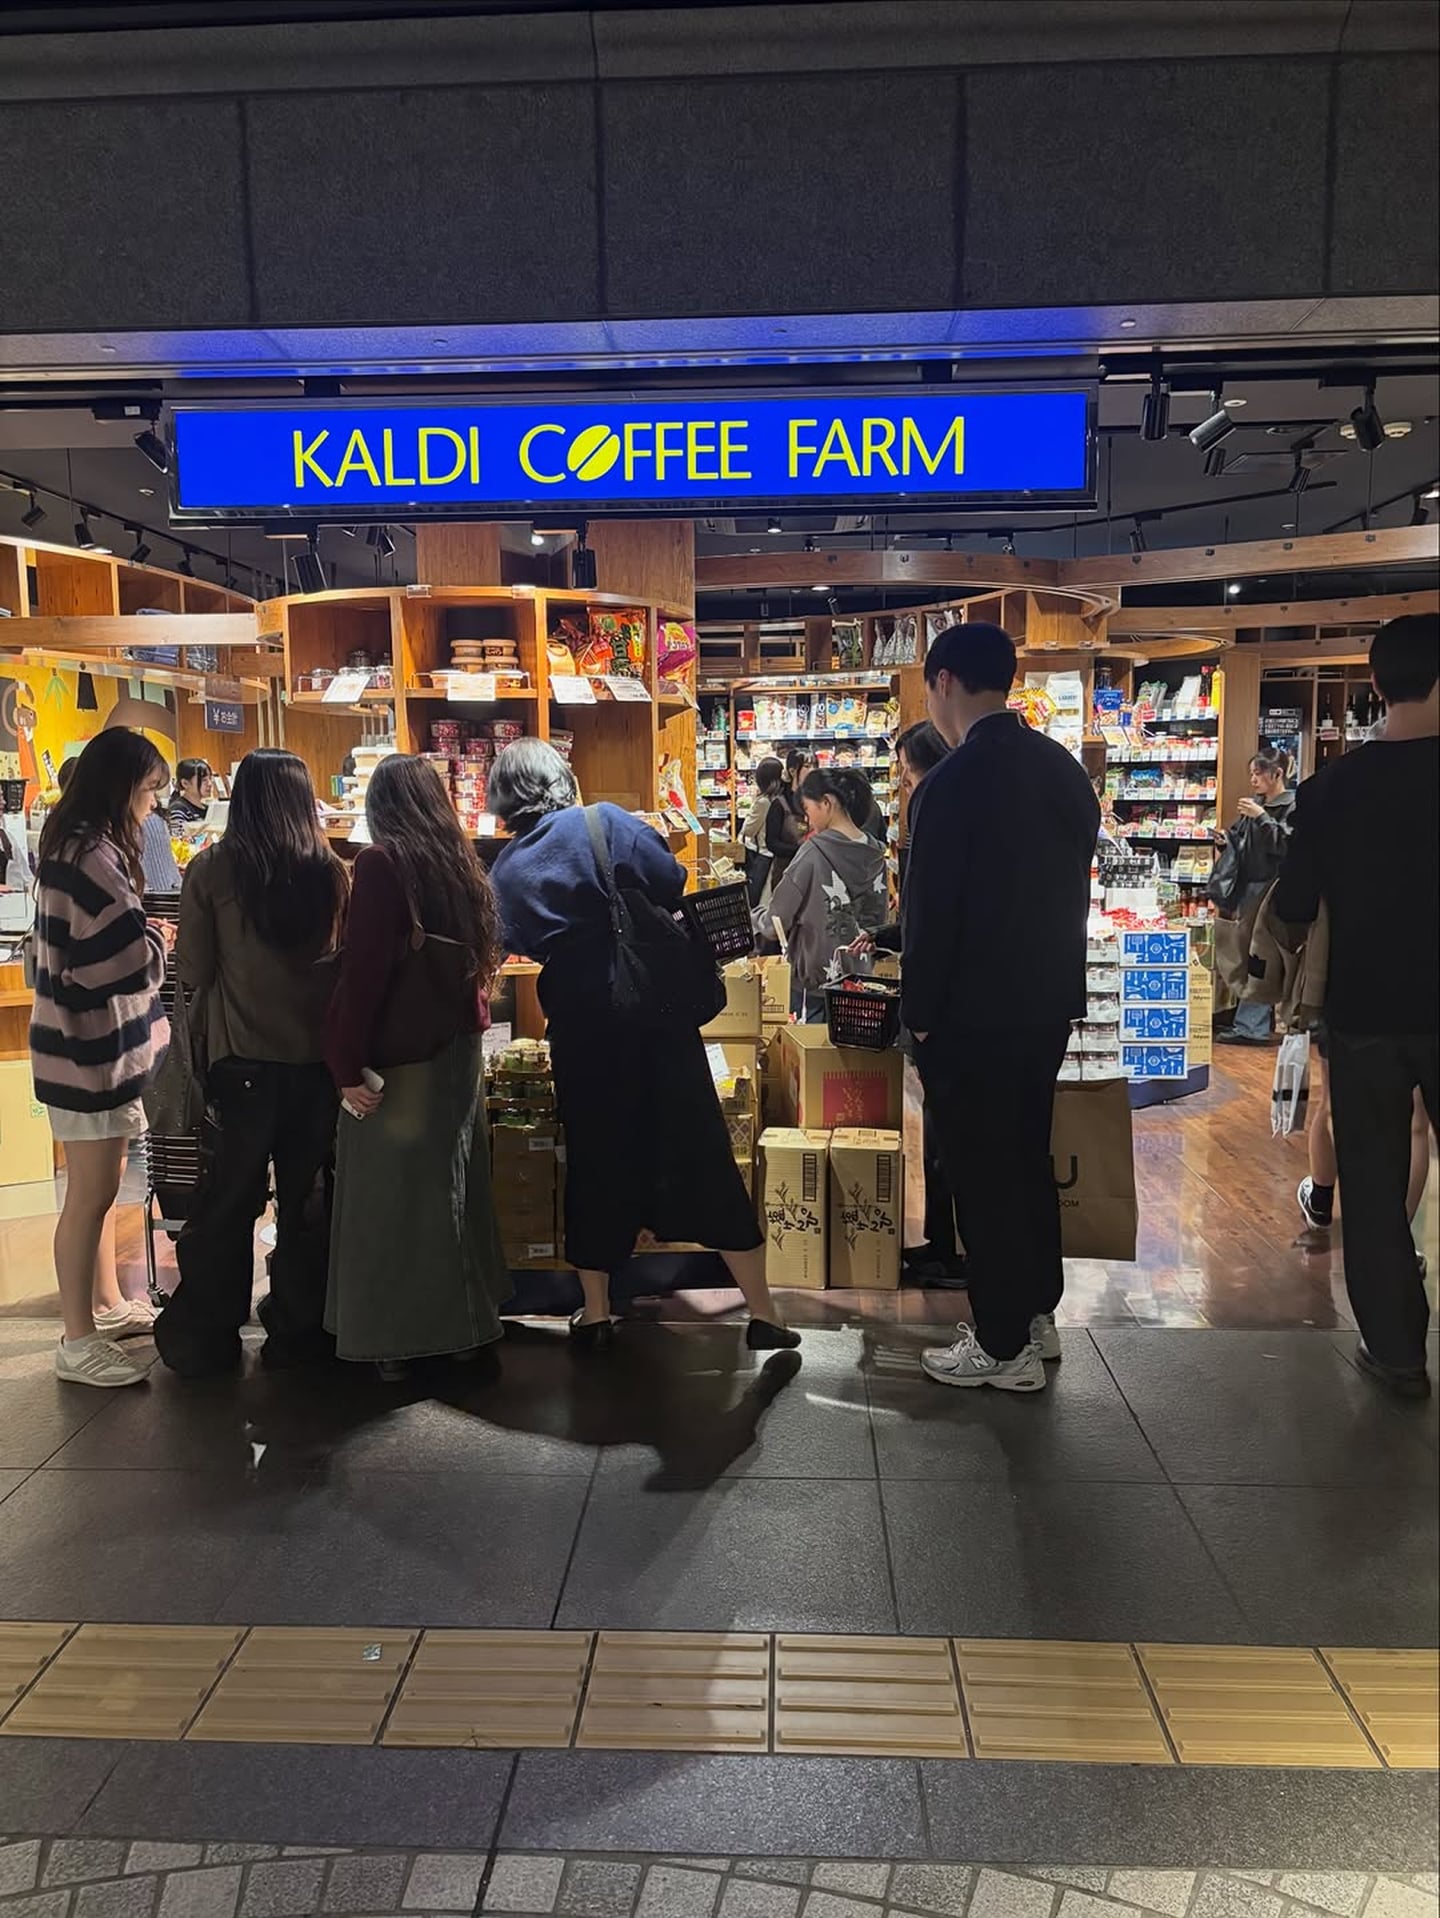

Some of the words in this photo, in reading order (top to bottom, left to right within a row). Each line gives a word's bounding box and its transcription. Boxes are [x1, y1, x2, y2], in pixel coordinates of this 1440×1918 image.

[293, 427, 480, 488] KALDI
[519, 420, 752, 484] COFFEE
[788, 416, 967, 478] FARM
